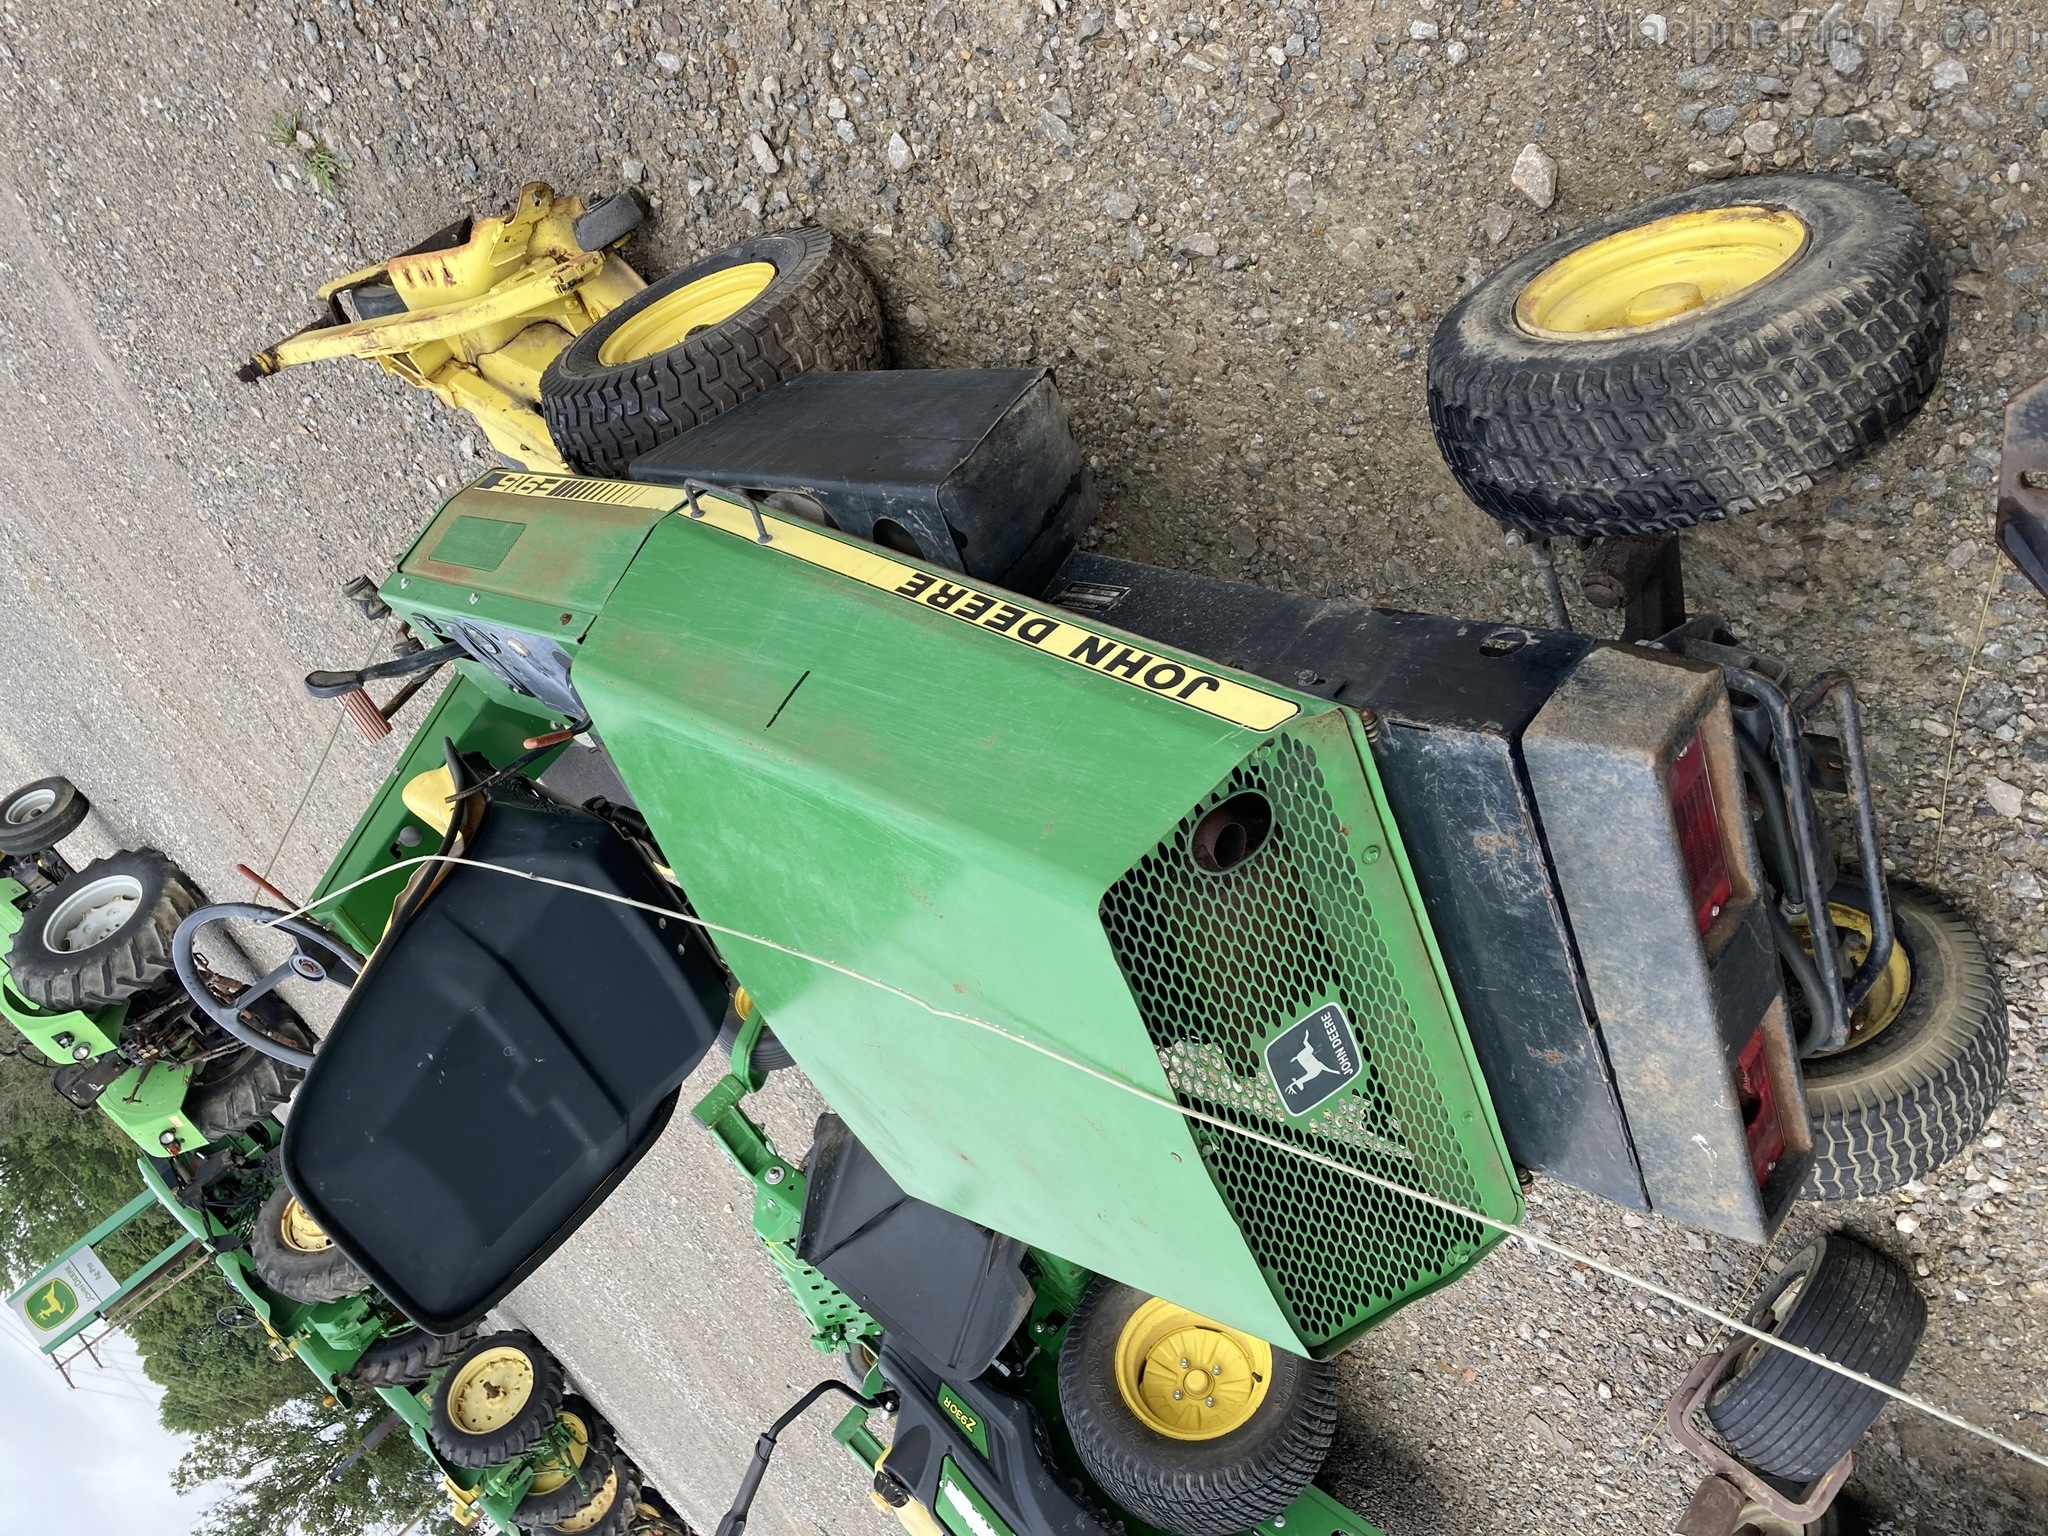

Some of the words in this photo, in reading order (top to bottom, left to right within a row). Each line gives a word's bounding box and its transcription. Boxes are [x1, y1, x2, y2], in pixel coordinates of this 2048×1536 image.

[896, 572, 1060, 645] DEERE
[1069, 637, 1220, 699] JOHN
[1321, 1011, 1342, 1049] DEERE
[1334, 1047, 1354, 1075] JOHN
[943, 1397, 977, 1433] Z930R
